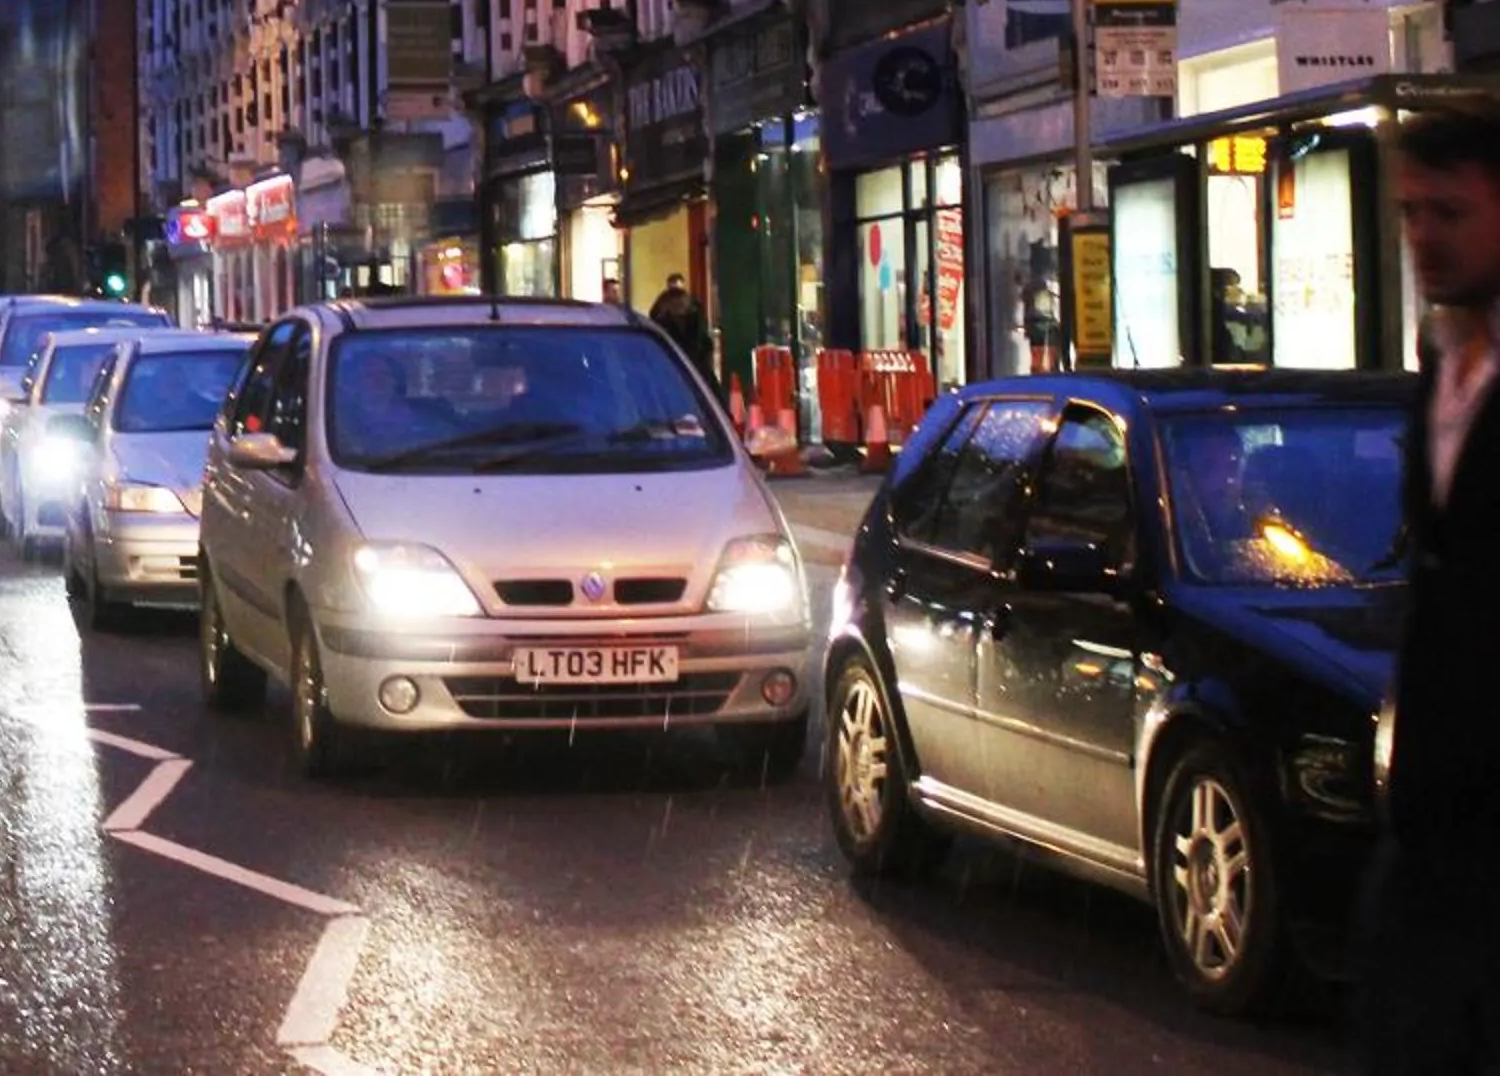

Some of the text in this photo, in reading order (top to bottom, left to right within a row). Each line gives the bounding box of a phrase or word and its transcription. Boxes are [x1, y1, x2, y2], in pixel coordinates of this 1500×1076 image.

[1294, 54, 1375, 68] WHISTLES
[527, 649, 666, 677] LT03 HFK
